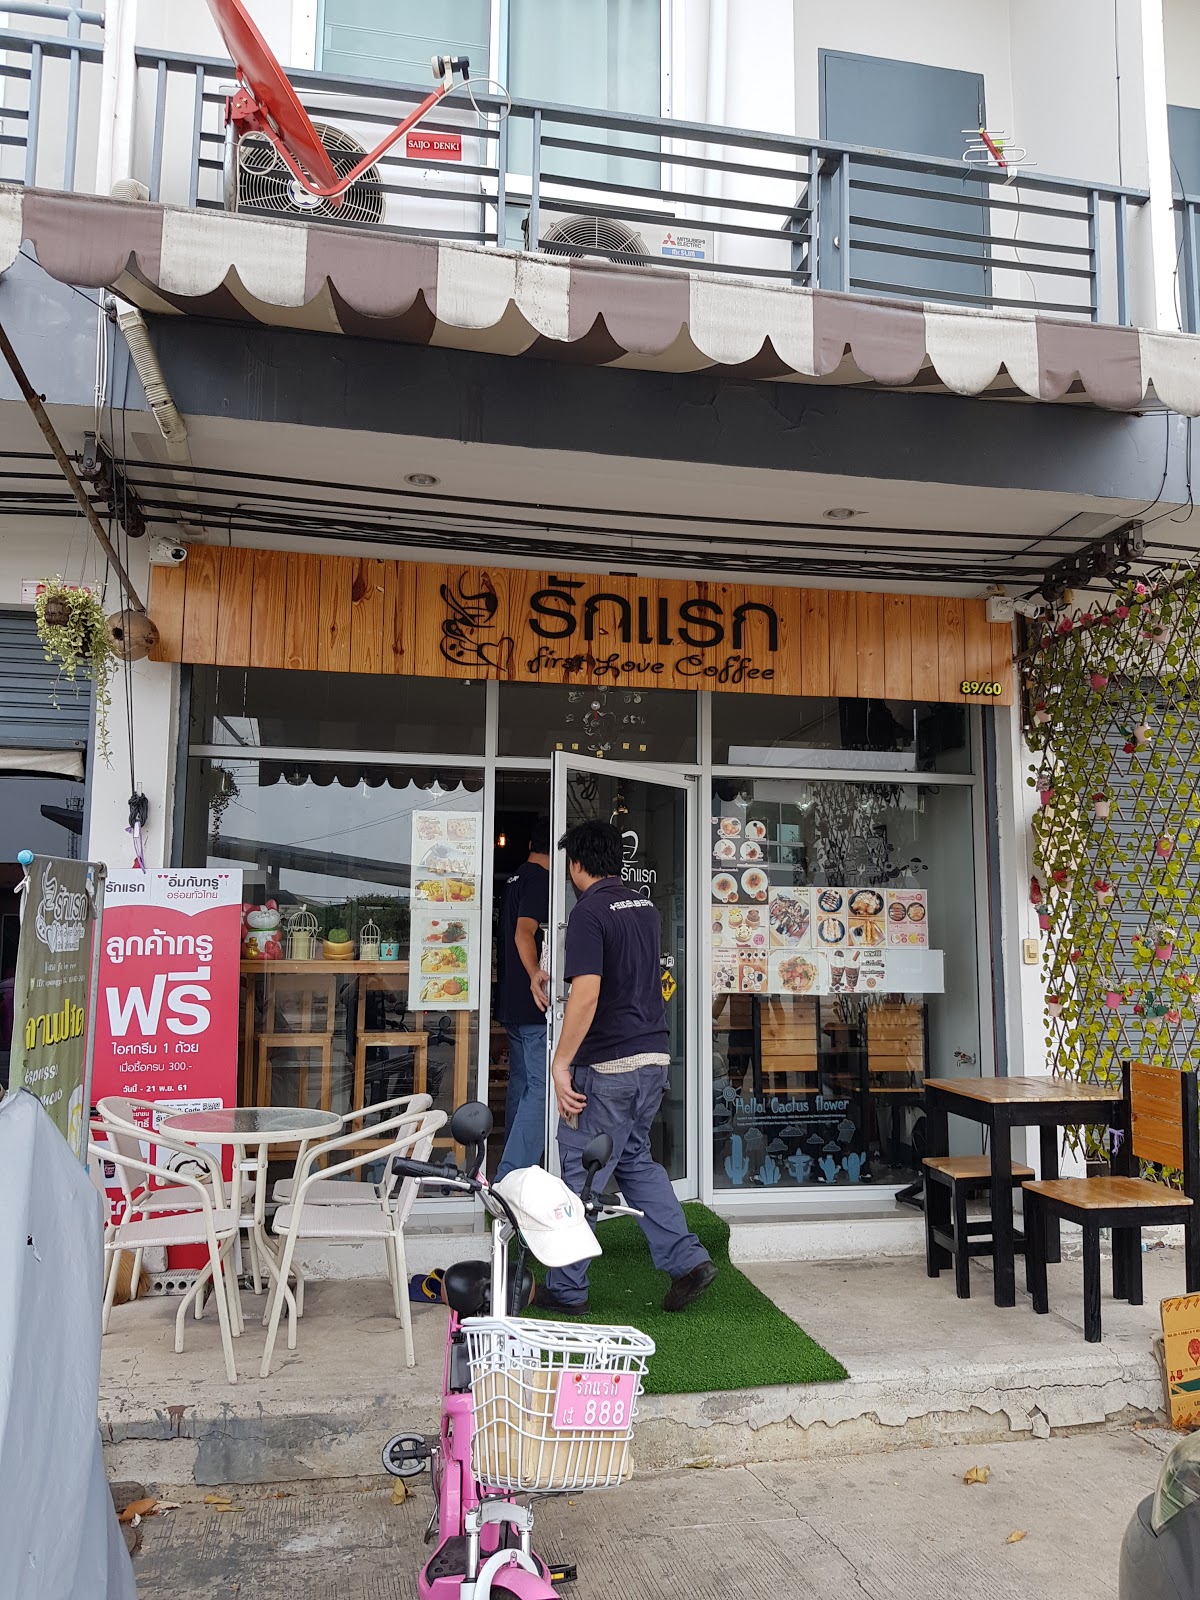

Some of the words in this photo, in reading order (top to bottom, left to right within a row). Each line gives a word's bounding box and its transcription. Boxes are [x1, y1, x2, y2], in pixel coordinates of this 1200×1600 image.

[408, 140, 430, 150] SAIJO
[433, 141, 460, 151] DENKI
[677, 236, 706, 244] MITSUBISHI
[528, 575, 778, 651] รักแรก
[593, 652, 664, 677] Love
[675, 654, 775, 683] Coffee
[961, 680, 1002, 696] 89/60
[168, 873, 219, 890] อิ่มกับทรู
[620, 863, 657, 884] รักแรก
[105, 880, 145, 893] รักแรก
[166, 888, 218, 899] อร่อยทั่วไทย
[106, 928, 213, 963] ลูกค้าทรู
[105, 966, 211, 1036] ฟรี
[111, 1041, 157, 1055] ไอศกรีม
[163, 1043, 168, 1053] 1
[175, 1040, 199, 1053] ถ้วย
[119, 1060, 164, 1072] เมื่อซื้อครบ
[168, 1062, 192, 1071] 300.-
[770, 1096, 809, 1114] Cactus
[575, 1374, 618, 1395] รักแรก
[584, 1400, 625, 1425] 888
